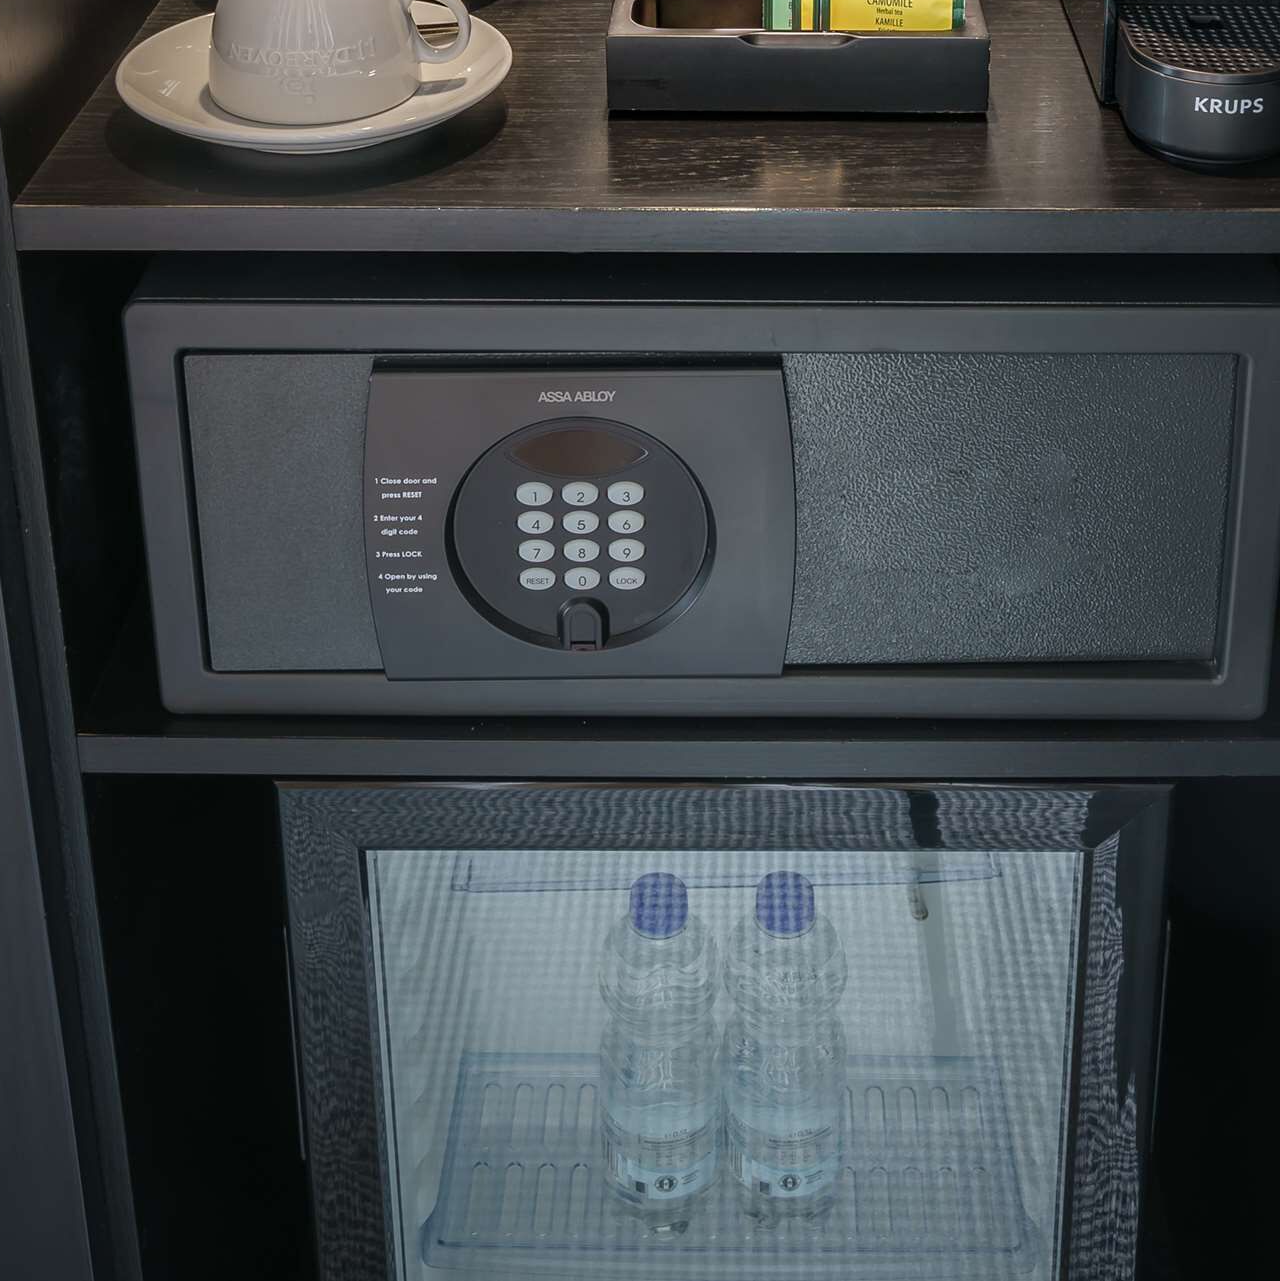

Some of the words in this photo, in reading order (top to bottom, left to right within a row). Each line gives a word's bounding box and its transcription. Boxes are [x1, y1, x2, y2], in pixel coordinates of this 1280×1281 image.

[875, 17, 903, 27] KAMILLE
[1194, 96, 1264, 114] KRUPS
[538, 391, 573, 402] ASSA
[574, 390, 616, 402] ABLOY
[381, 492, 401, 500] press
[576, 491, 585, 503] 2
[622, 491, 631, 503] 3
[531, 519, 540, 531] 4
[577, 519, 586, 531] 5
[622, 519, 631, 531] 6
[380, 528, 397, 536] digit
[532, 548, 541, 559] 7
[578, 548, 586, 559] 8
[622, 548, 631, 559] 9
[384, 573, 405, 581] Open
[406, 573, 416, 581] by
[578, 576, 586, 587] 0
